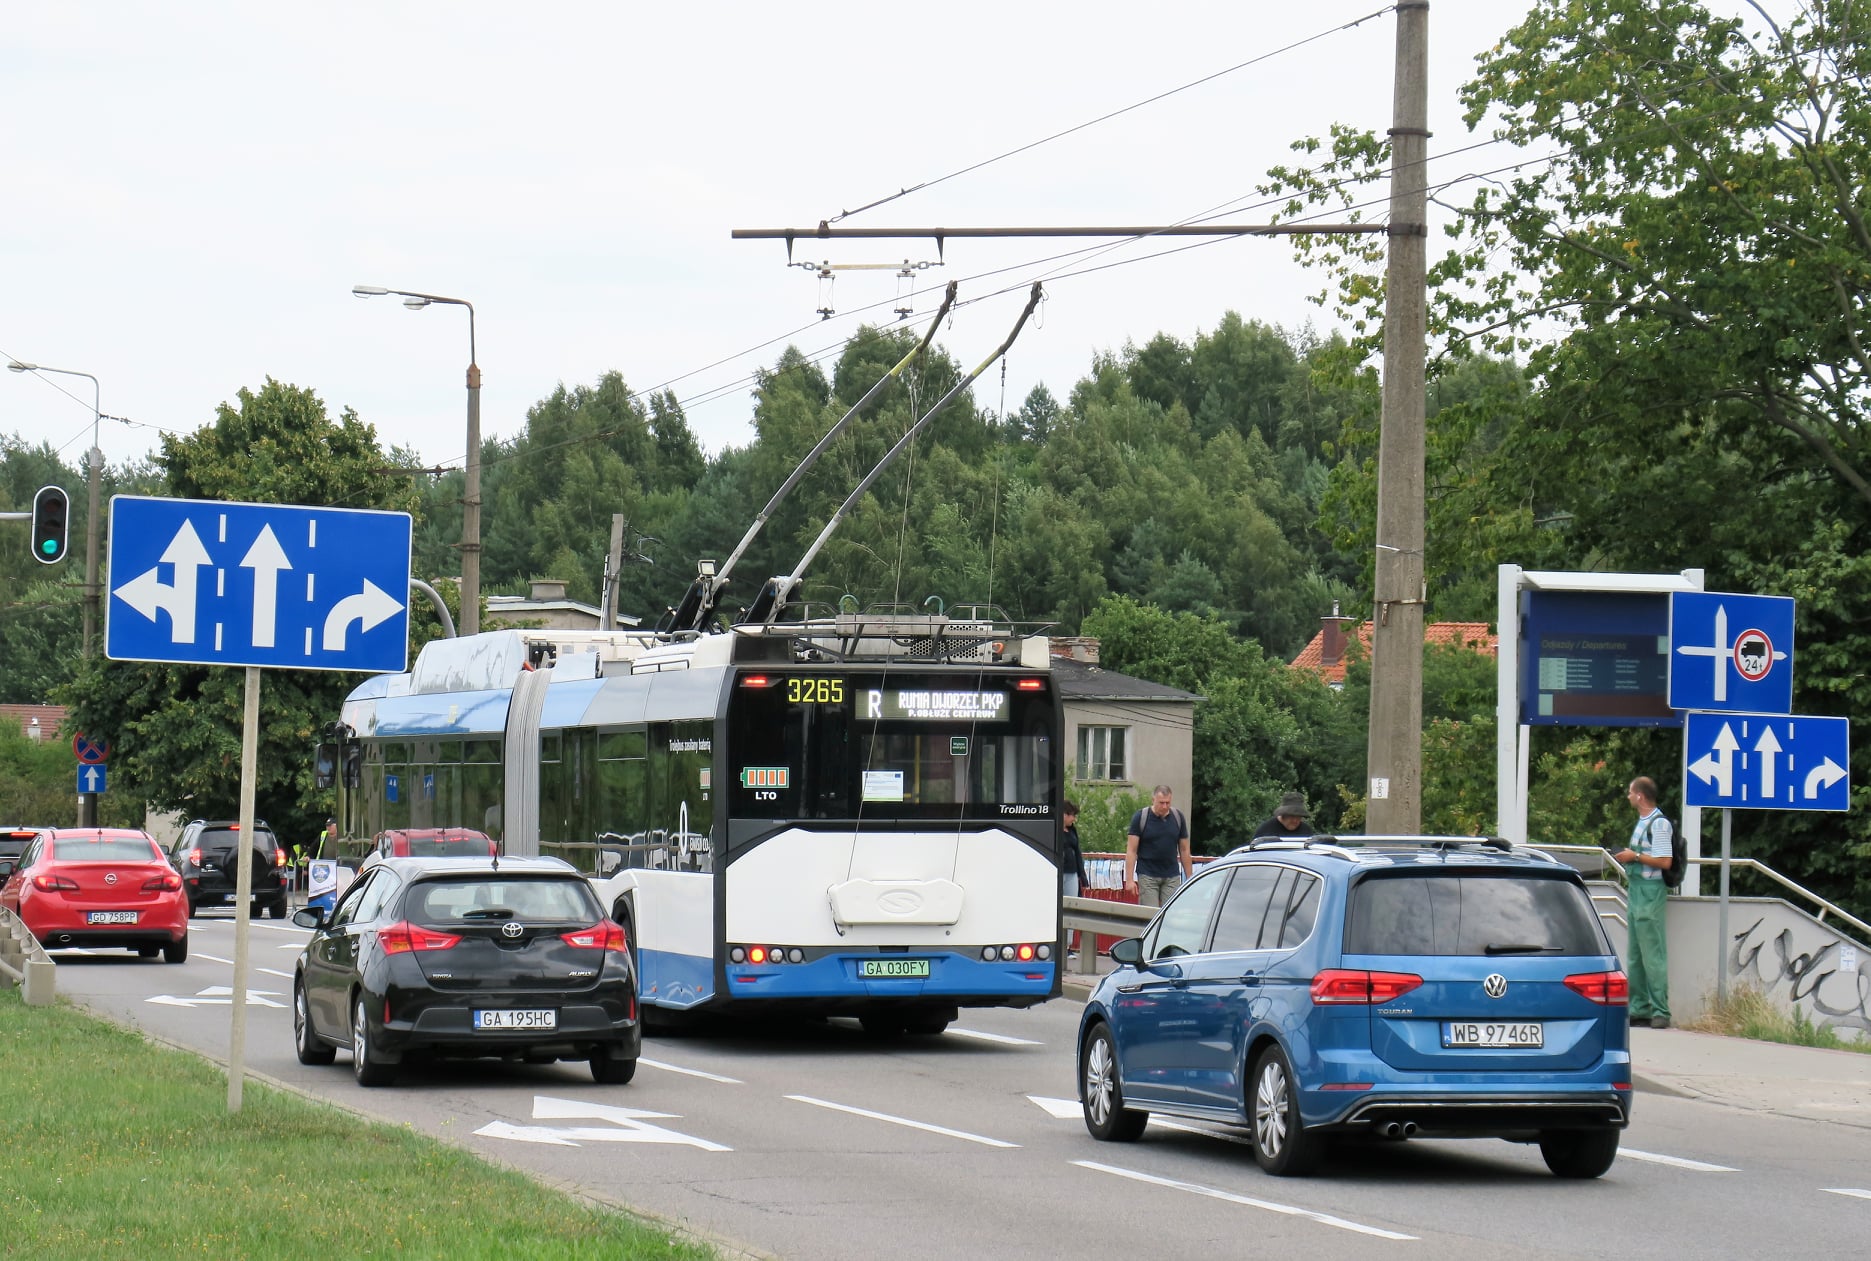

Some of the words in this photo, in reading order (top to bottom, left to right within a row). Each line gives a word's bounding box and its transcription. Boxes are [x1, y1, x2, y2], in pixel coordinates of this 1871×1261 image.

[788, 679, 843, 703] 3265
[868, 690, 882, 718] R
[899, 691, 930, 709] RUMIA
[931, 692, 980, 710] DWORZEC
[981, 693, 1004, 710] PKP
[953, 709, 996, 719] CENTRUM
[755, 791, 777, 800] LTO
[1000, 804, 1037, 815] Trollino
[1038, 805, 1049, 815] 18
[94, 913, 106, 922] GD
[109, 912, 136, 922] 758PP
[866, 962, 883, 975] GA
[887, 961, 926, 975] 030FY
[483, 1011, 502, 1026] GA
[508, 1011, 552, 1026] 195HC
[1454, 1024, 1480, 1043] WB
[1485, 1024, 1541, 1043] 9746R
